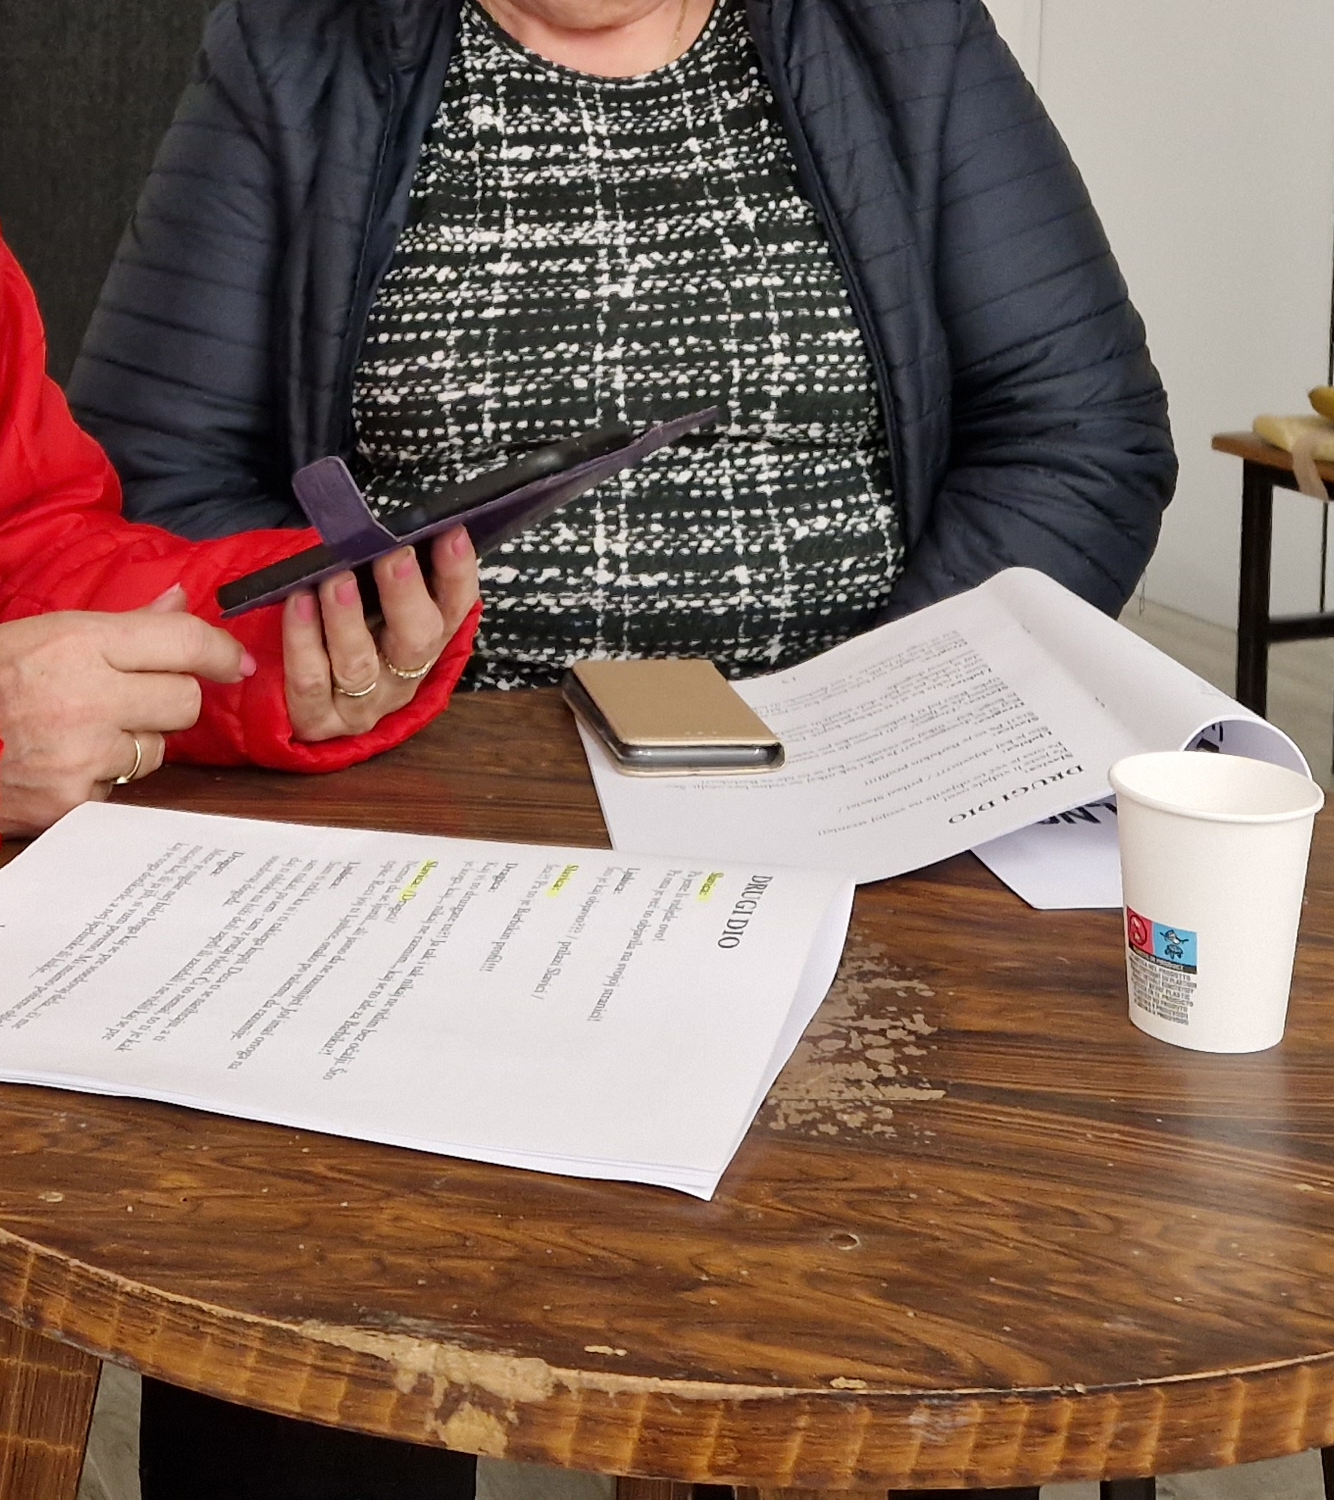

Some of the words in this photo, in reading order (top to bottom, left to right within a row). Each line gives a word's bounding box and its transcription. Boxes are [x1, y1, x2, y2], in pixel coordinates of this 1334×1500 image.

[1001, 764, 1083, 802] DRUGI
[947, 799, 995, 824] DIO
[731, 874, 772, 915] DRUGI
[717, 918, 749, 949] DIO
